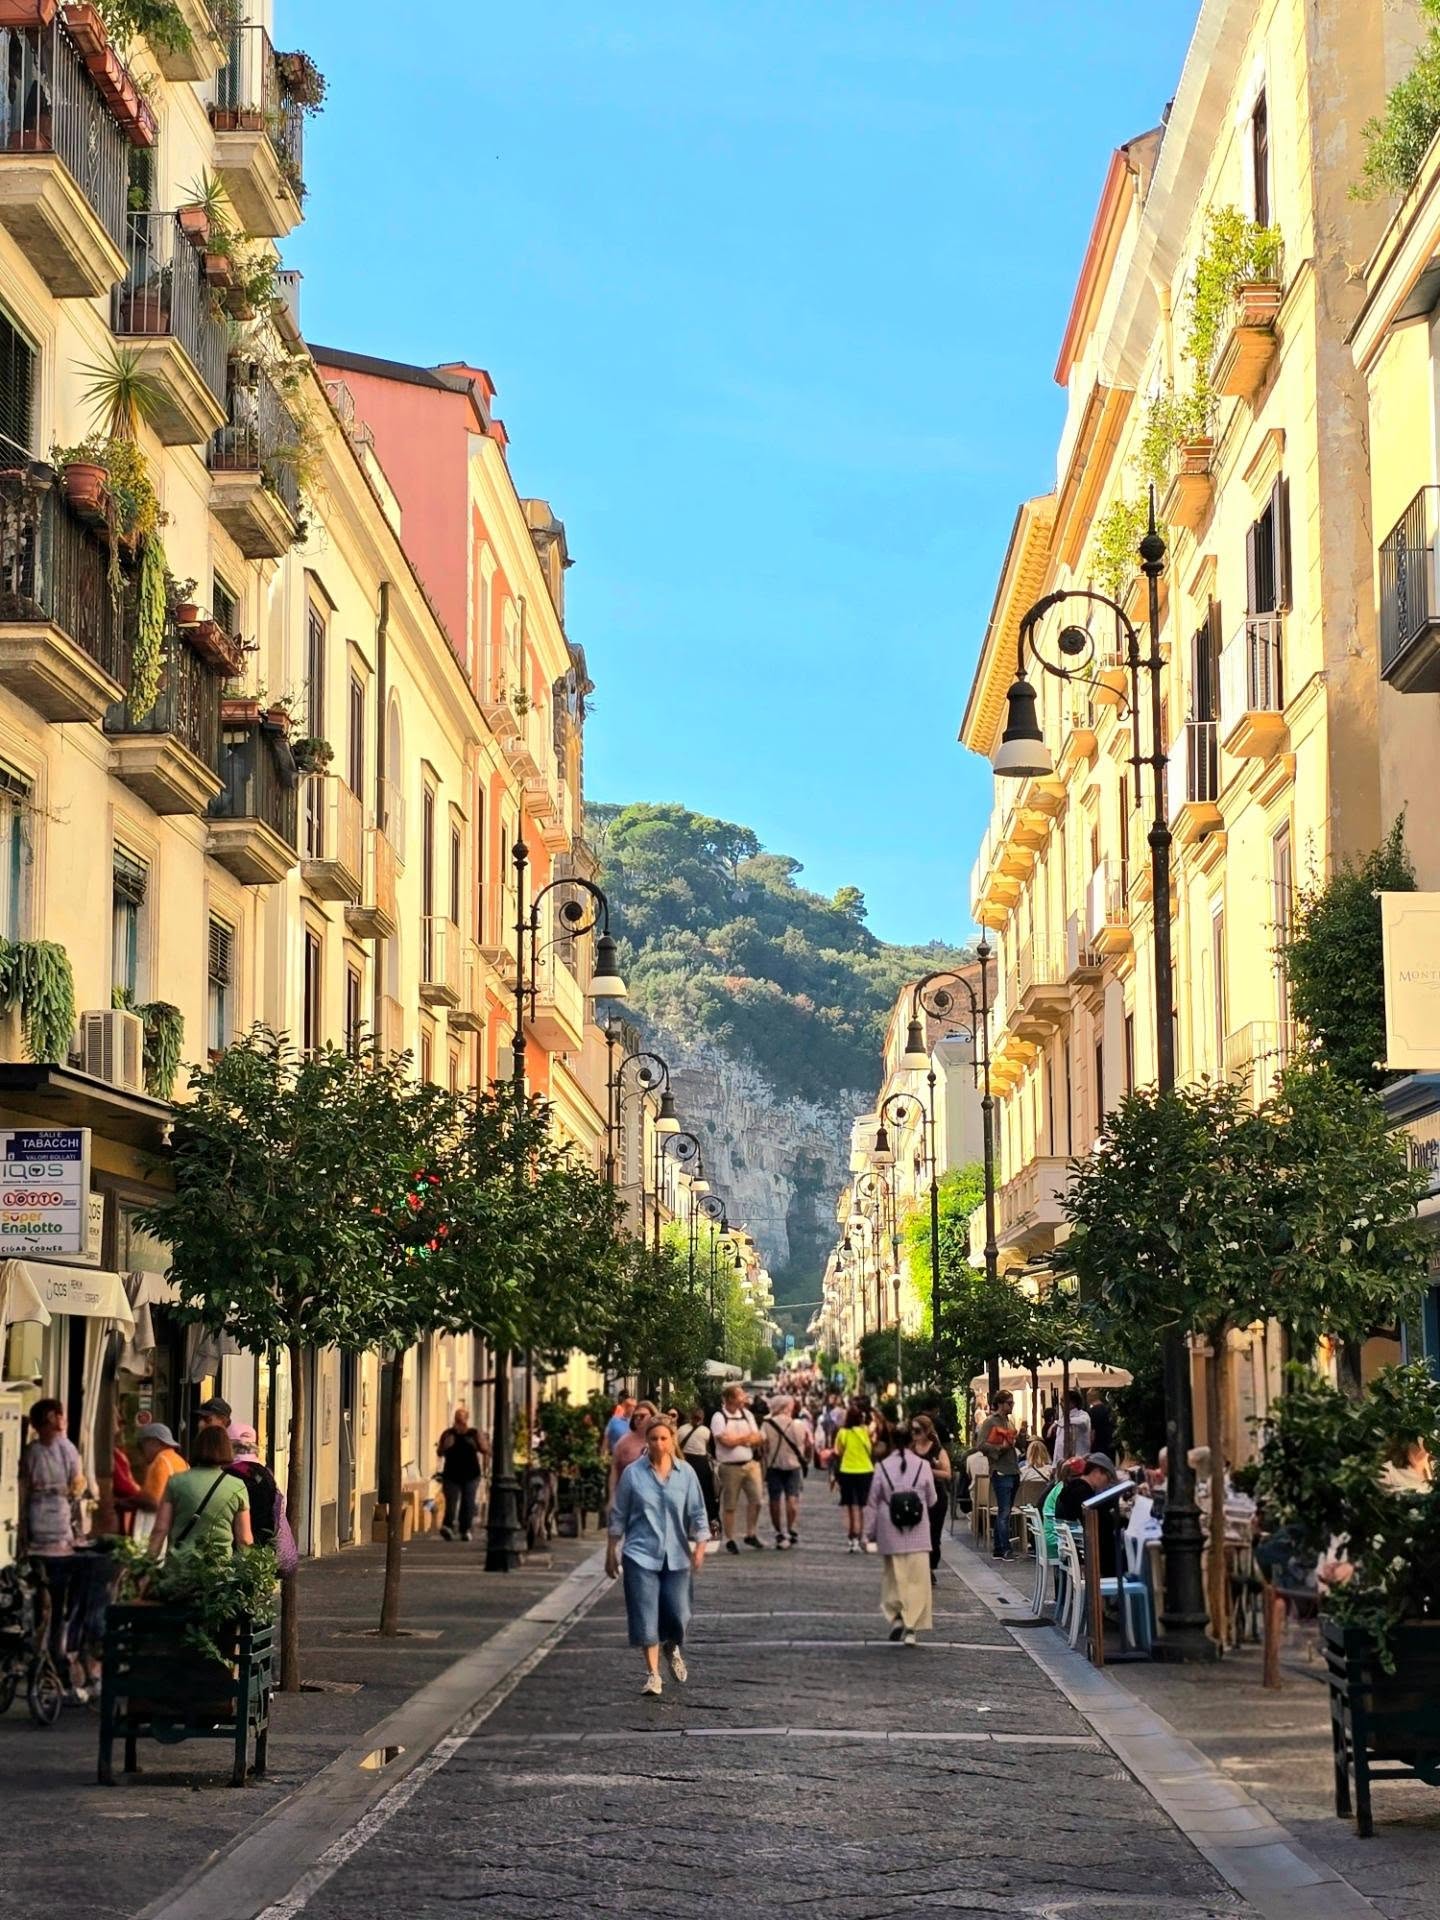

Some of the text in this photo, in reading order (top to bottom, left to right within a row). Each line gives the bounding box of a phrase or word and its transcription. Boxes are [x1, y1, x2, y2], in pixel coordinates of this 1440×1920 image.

[22, 1138, 79, 1148] TABACCHI
[3, 1163, 64, 1179] IQOS
[3, 1192, 63, 1206] LOTTO
[2, 1211, 42, 1222] Super
[1, 1222, 63, 1234] Enalotto
